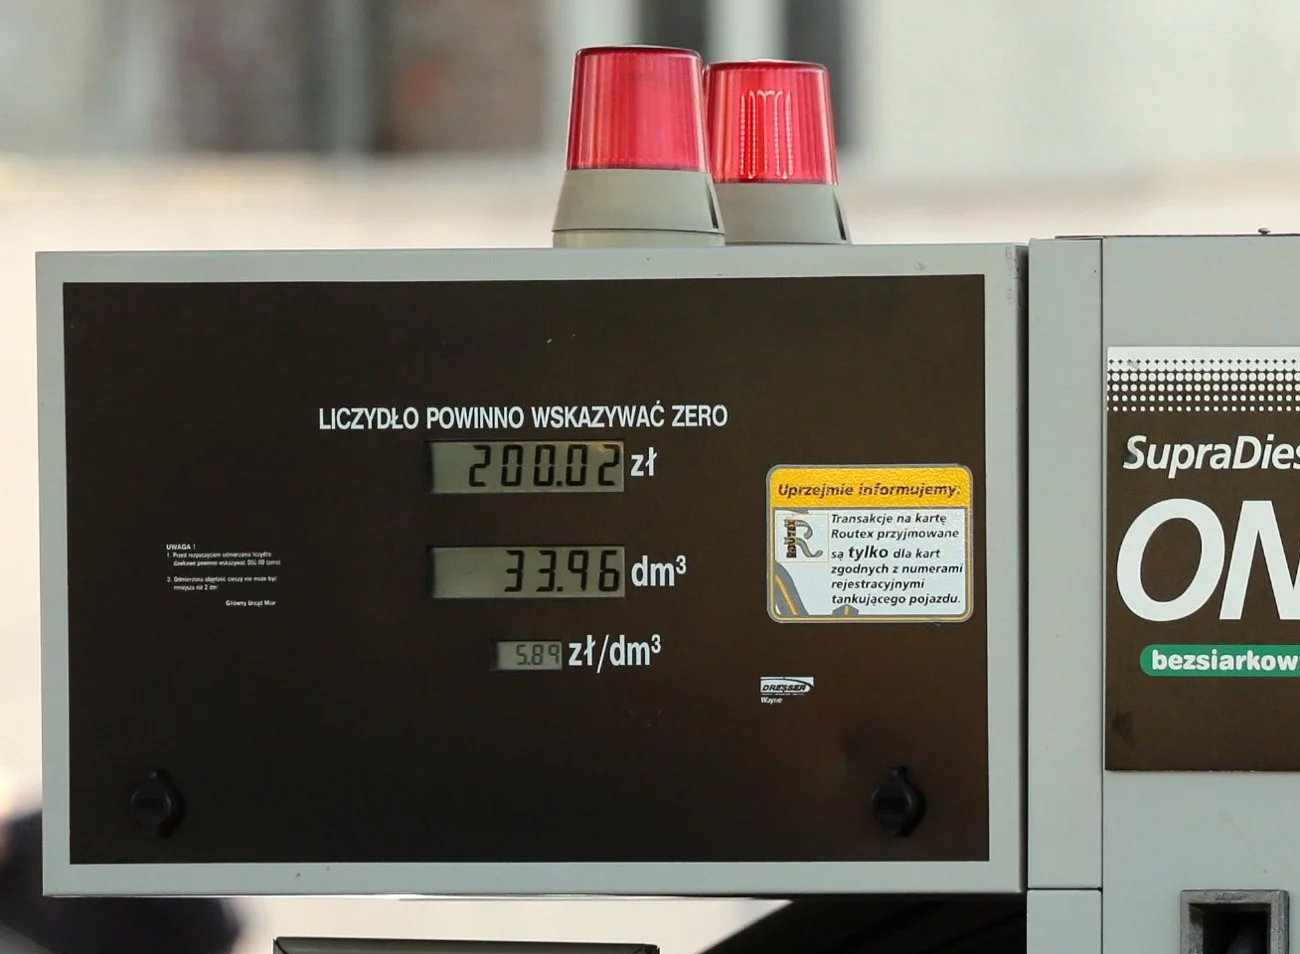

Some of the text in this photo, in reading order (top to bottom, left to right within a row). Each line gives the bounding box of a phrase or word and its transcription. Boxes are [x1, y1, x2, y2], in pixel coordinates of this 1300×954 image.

[319, 400, 728, 430] LICZYDŁO POWINNO WSKAZYWAĆ ZERO
[468, 444, 620, 488] 200.02
[630, 447, 657, 477] zł
[778, 483, 854, 499] Uprzejmie
[831, 513, 947, 526] Transakcje na kartę
[831, 529, 959, 541] Routex przyjmowane
[831, 545, 941, 562] są tylko dla kart
[504, 550, 620, 592] 33.96
[831, 564, 963, 576] zgodnych z numerami
[831, 579, 925, 592] rejestracyjnymi
[831, 593, 961, 606] tankującego pojazdu.
[516, 644, 560, 666] 5.89
